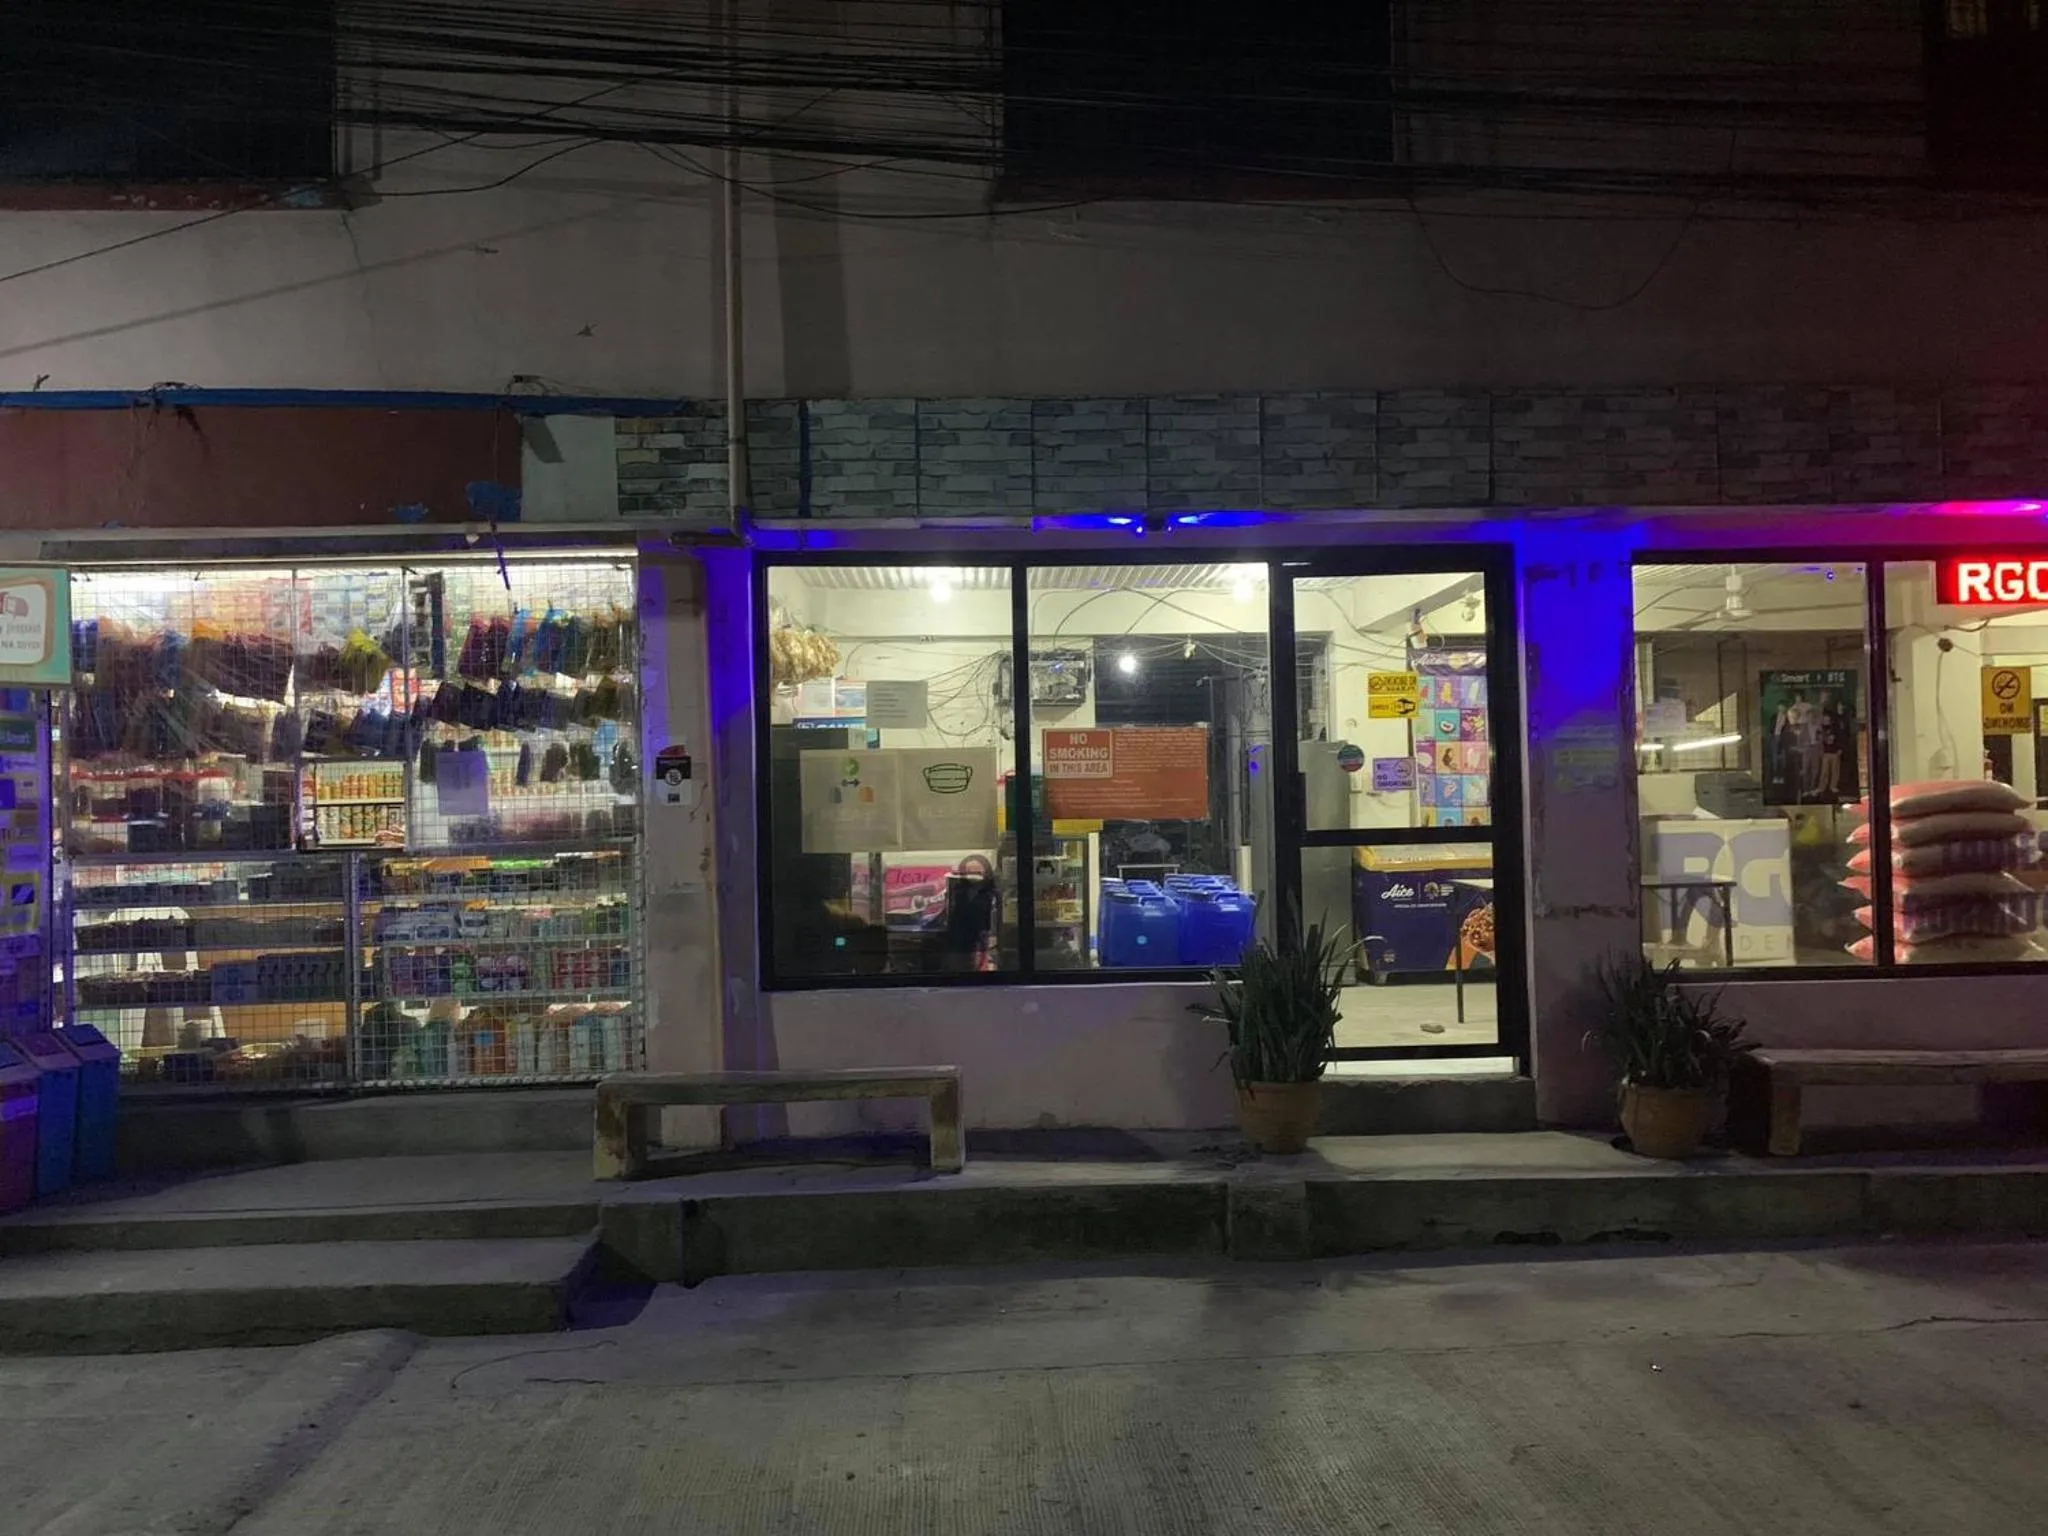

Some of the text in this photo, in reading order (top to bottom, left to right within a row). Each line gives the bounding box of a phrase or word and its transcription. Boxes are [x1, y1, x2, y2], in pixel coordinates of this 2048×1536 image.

[1068, 733, 1088, 745] NO
[1048, 747, 1109, 760] SMOKING
[1049, 761, 1108, 773] IN THIS AREA
[1381, 884, 1415, 900] Aice
